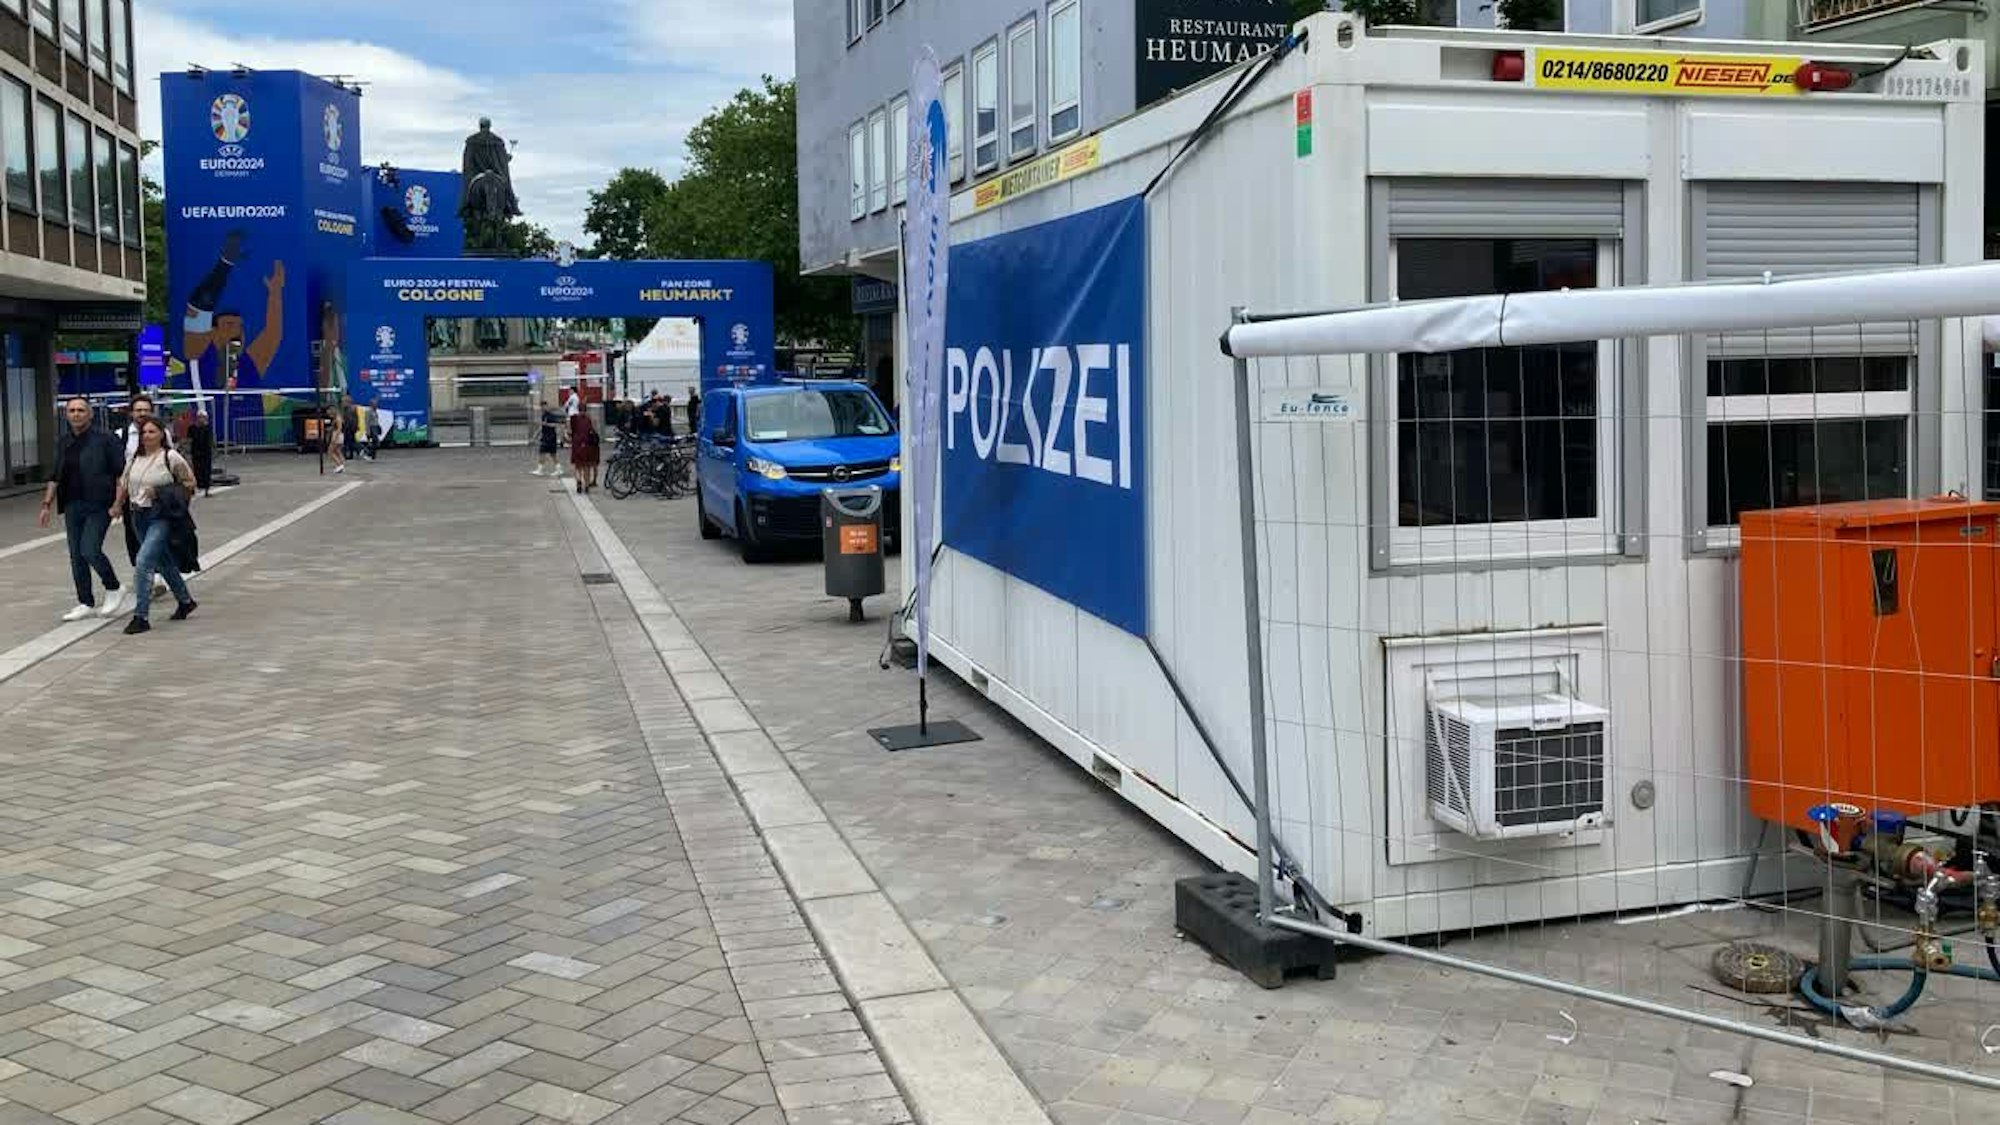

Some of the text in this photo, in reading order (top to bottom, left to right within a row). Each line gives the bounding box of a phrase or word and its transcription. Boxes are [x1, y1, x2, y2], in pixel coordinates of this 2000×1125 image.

[1170, 19, 1287, 38] RESTAURANT
[1146, 37, 1279, 63] HEUMAR
[1542, 60, 1669, 83] 0214/8680220
[200, 158, 265, 170] EURO2024
[384, 279, 500, 288] EURO 2024 FESTIVAL
[661, 279, 713, 289] FAN ZONE
[398, 289, 484, 301] COLOGNE
[541, 286, 595, 297] EURO2024
[640, 288, 733, 302] HEUMARKT
[947, 343, 1131, 489] POLIZEI
